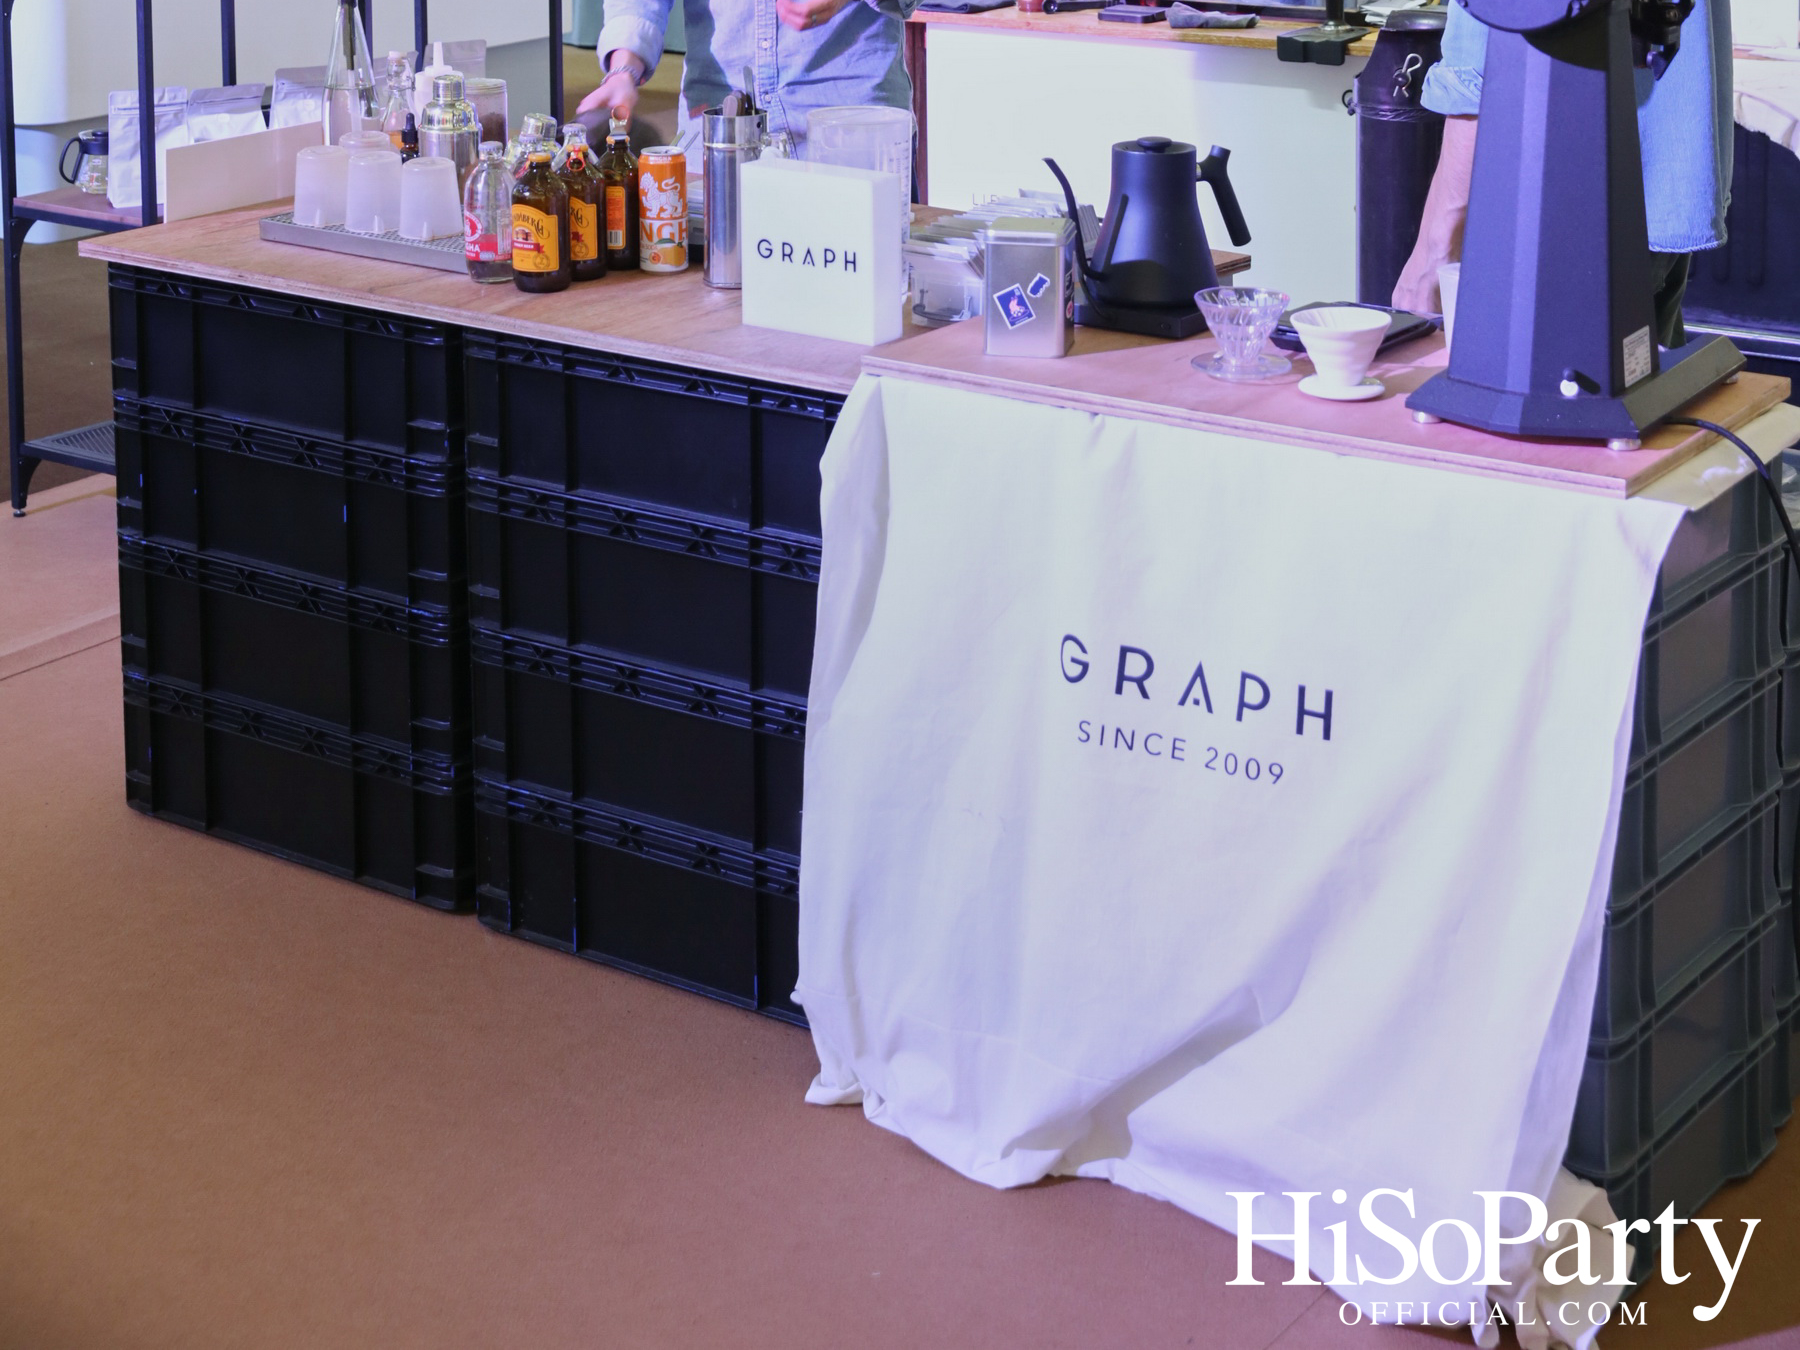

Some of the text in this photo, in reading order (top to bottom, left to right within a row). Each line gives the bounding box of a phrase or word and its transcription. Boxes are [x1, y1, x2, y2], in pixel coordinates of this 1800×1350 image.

[757, 238, 857, 273] GRAPH
[1060, 633, 1334, 742] GRAPH
[1077, 720, 1285, 785] SINCE 2009
